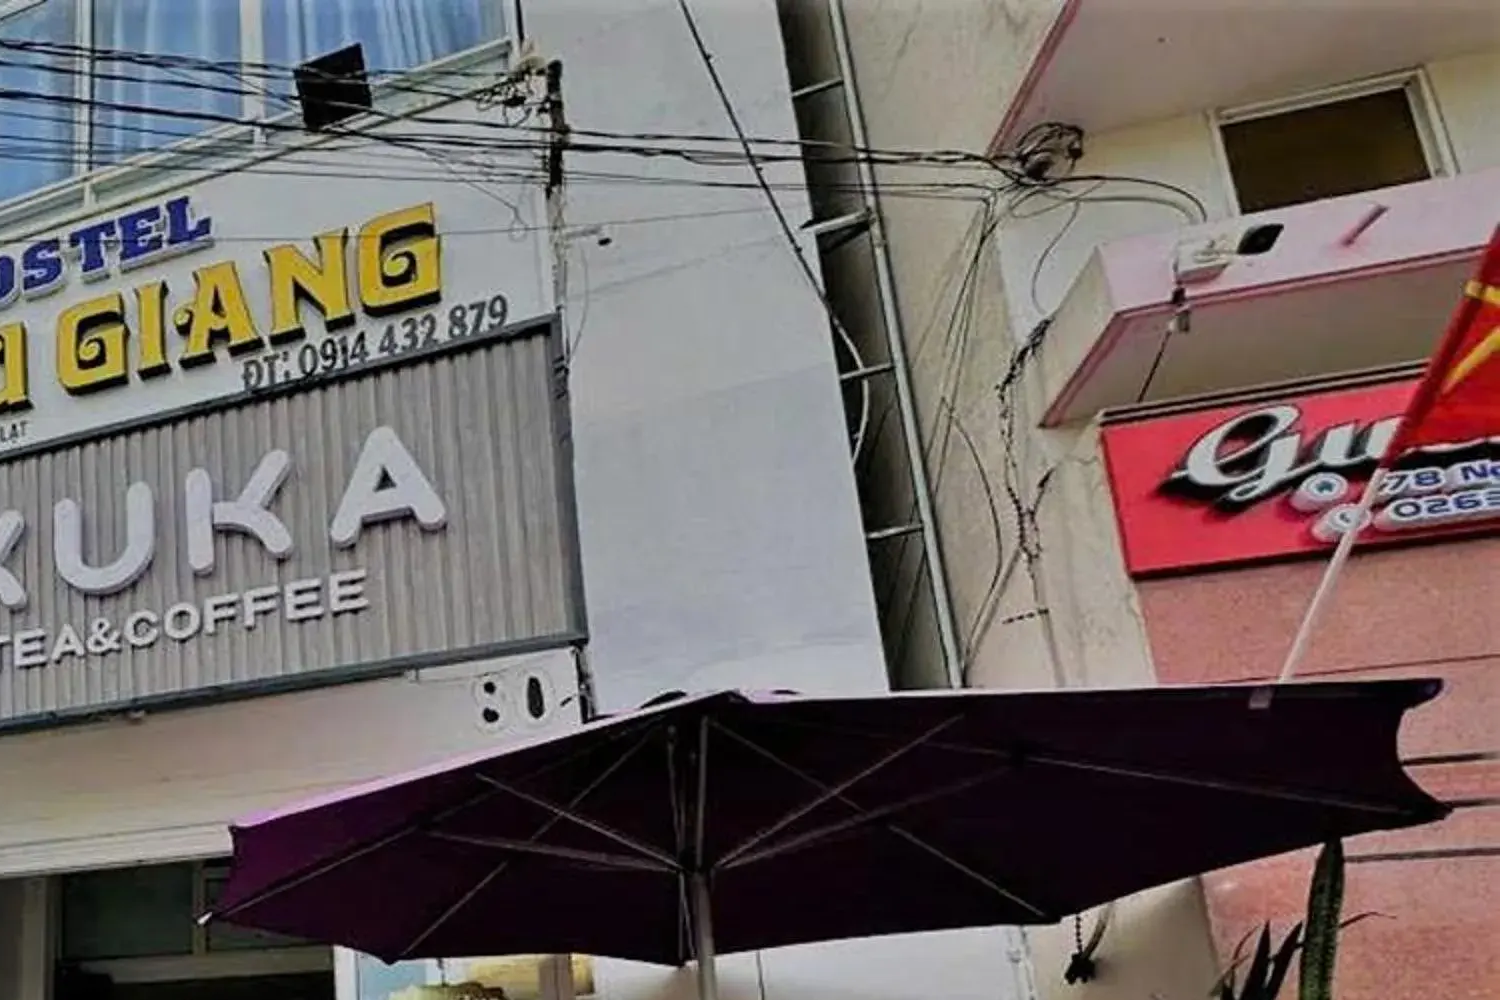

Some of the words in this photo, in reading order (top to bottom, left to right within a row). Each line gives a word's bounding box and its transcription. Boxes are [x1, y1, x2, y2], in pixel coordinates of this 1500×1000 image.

[56, 202, 442, 394] GIANG
[298, 331, 369, 378] 0914
[378, 313, 438, 356] 432
[448, 295, 509, 338] 879
[0, 420, 30, 447] LẠT
